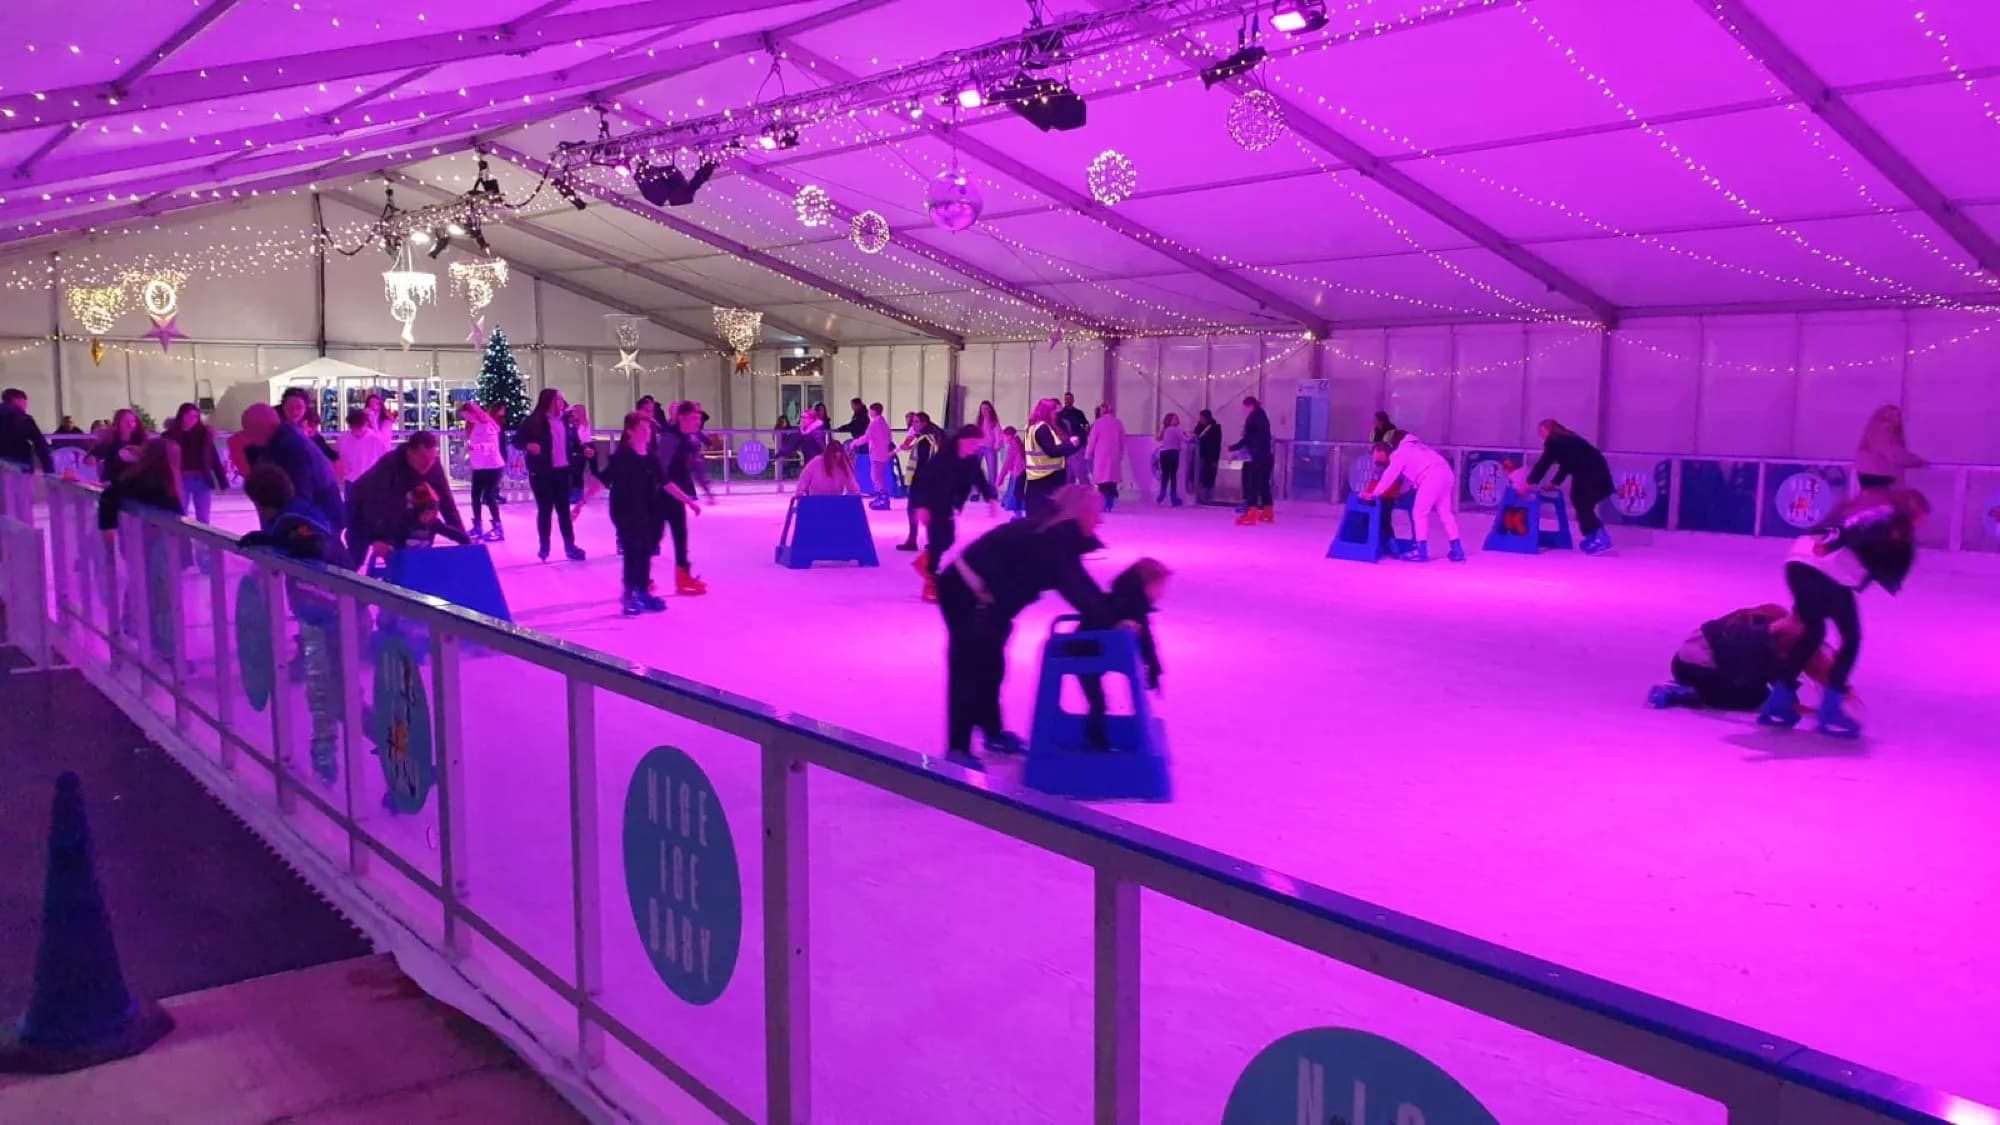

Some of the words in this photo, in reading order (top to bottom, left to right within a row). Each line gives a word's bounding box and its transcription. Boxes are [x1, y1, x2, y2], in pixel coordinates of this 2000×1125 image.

[649, 767, 708, 847] NICE
[660, 839, 700, 910] ICE
[649, 898, 711, 985] BABY
